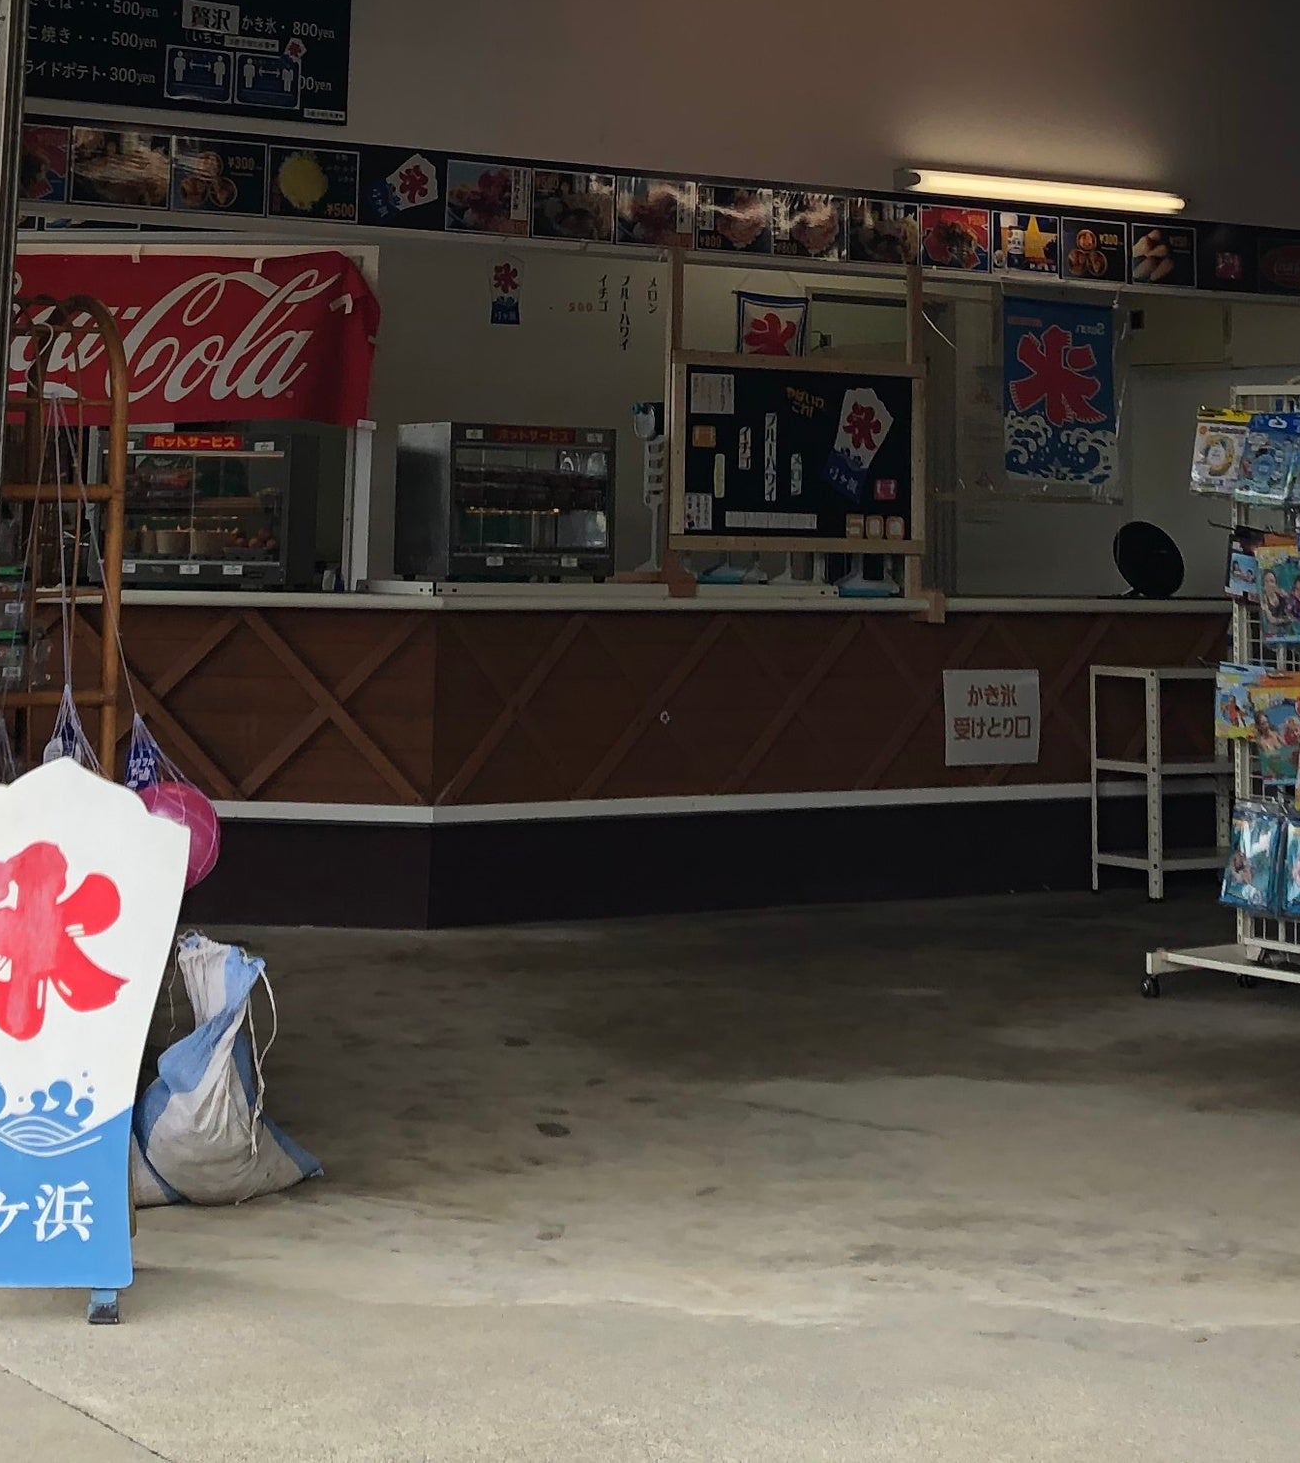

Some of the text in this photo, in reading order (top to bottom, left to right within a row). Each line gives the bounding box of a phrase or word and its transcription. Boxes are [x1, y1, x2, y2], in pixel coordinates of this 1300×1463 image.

[299, 73, 333, 93] 00yen
[399, 164, 429, 204] 氷
[493, 263, 518, 294] 氷
[153, 435, 237, 448] ホットサービス
[967, 683, 1018, 707] かき氷
[954, 716, 1031, 741] 受けとり口
